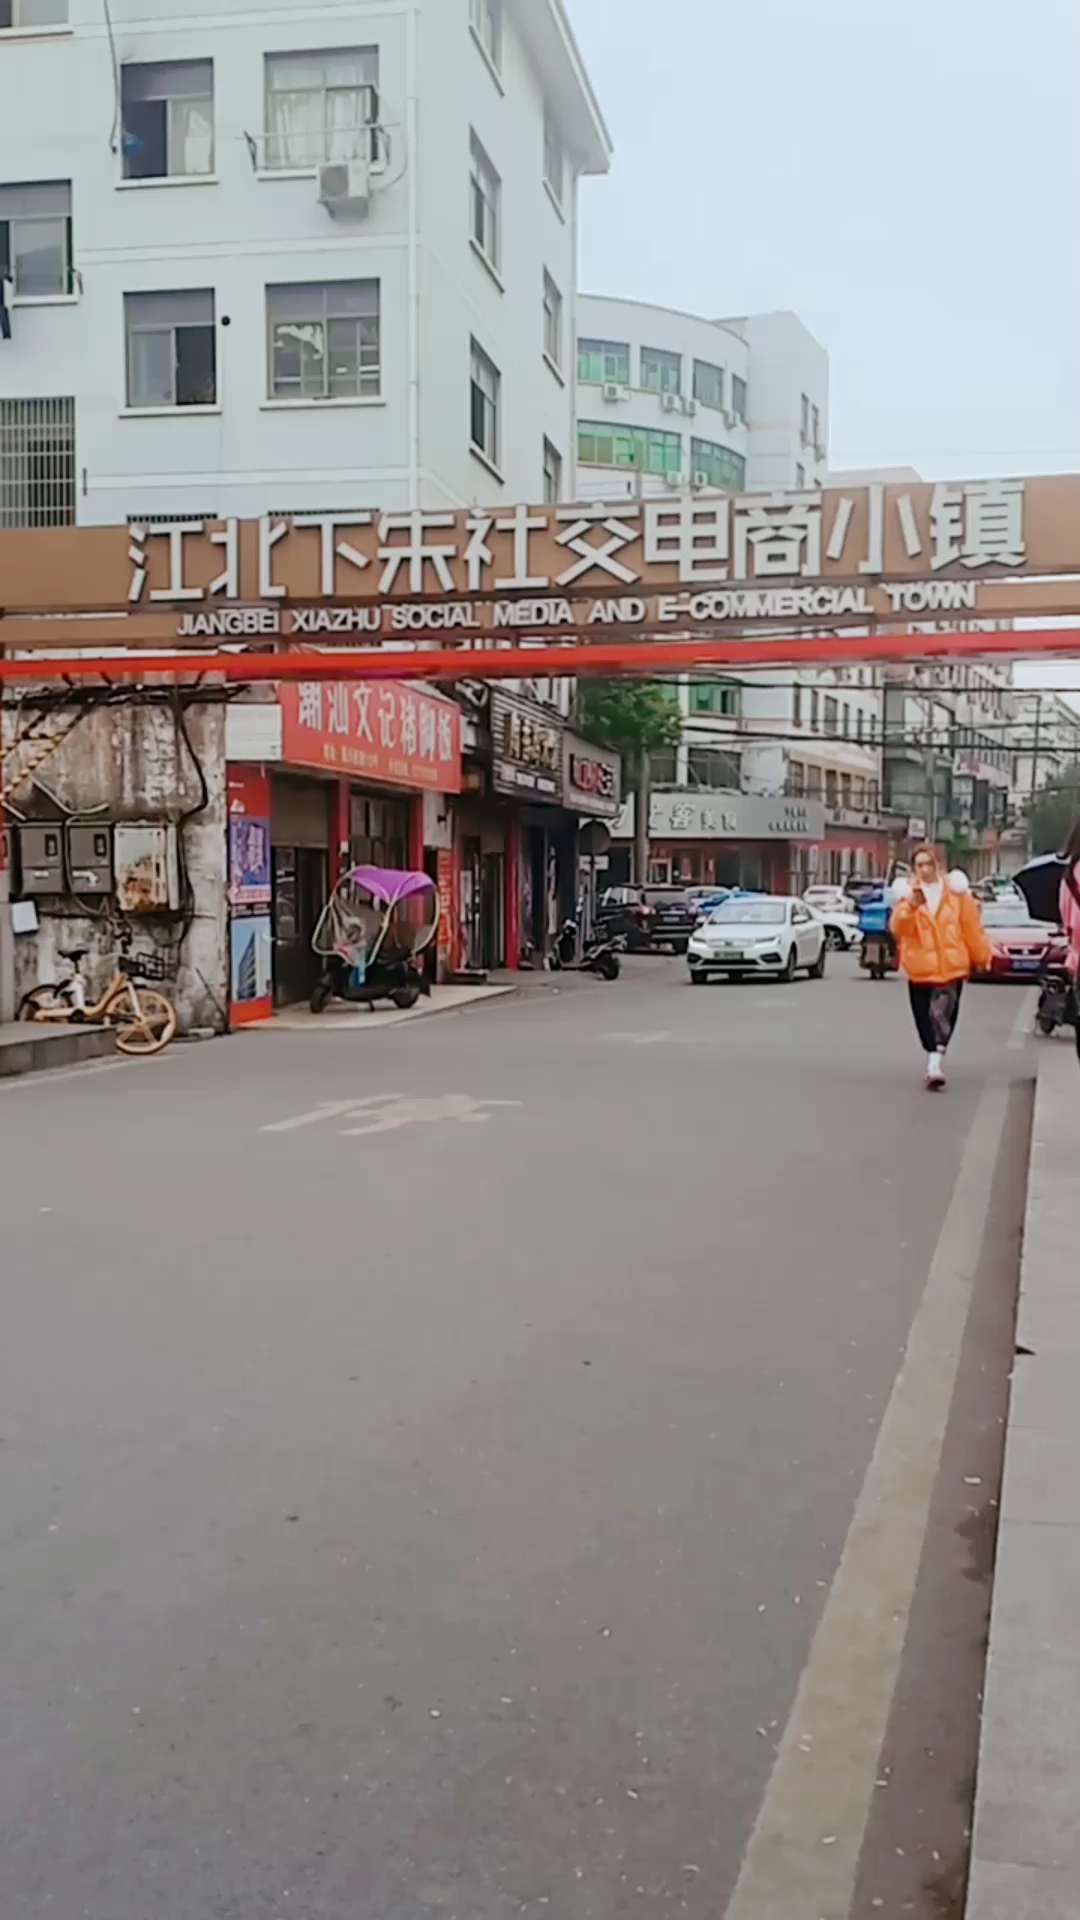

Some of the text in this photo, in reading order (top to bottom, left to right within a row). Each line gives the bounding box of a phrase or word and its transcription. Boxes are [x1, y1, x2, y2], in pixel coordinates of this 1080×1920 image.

[127, 480, 1027, 601] 江北下朱社交电商小镇
[177, 582, 977, 636] JIANGBEI XIAZHU SOCIAL MEDIA AND E-COMMERCIAL TOWN
